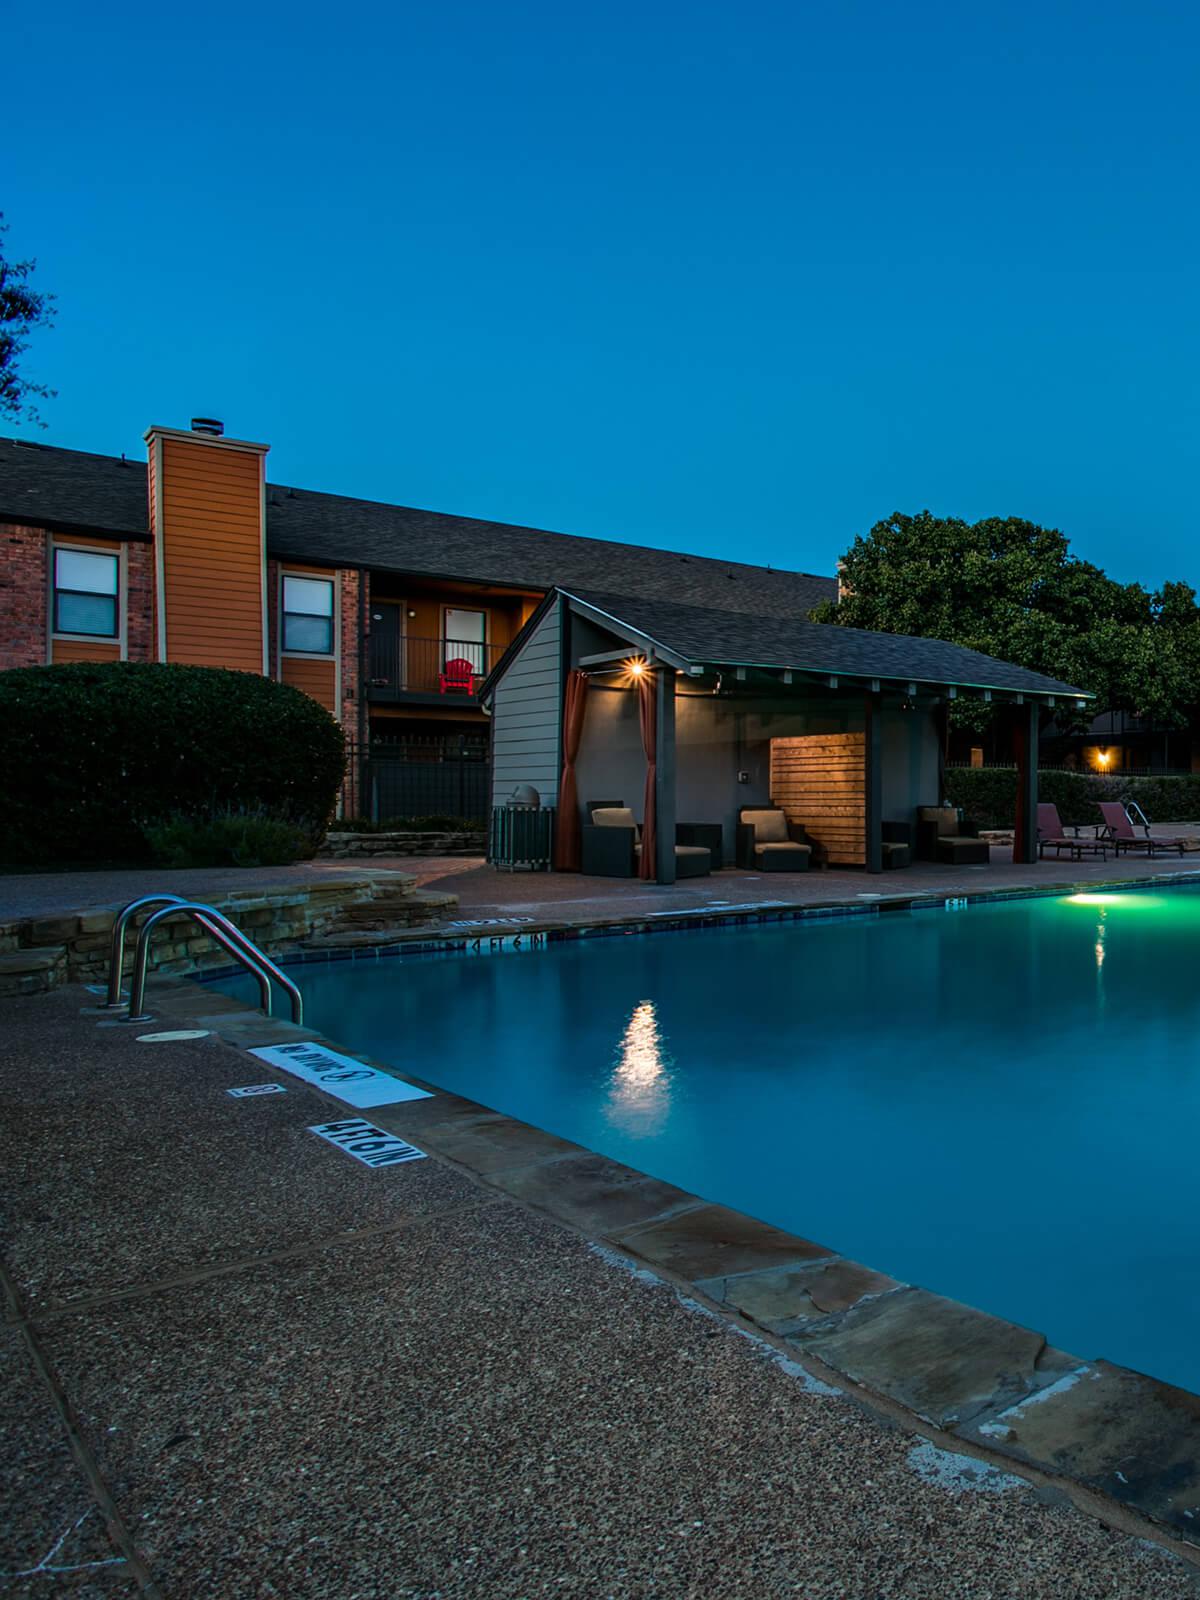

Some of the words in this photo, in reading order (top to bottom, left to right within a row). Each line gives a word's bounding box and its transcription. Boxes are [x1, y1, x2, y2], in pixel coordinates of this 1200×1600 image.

[289, 1053, 345, 1072] DIVING
[319, 1122, 368, 1133] 4
[348, 1140, 403, 1152] 6
[361, 1146, 422, 1165] IN
